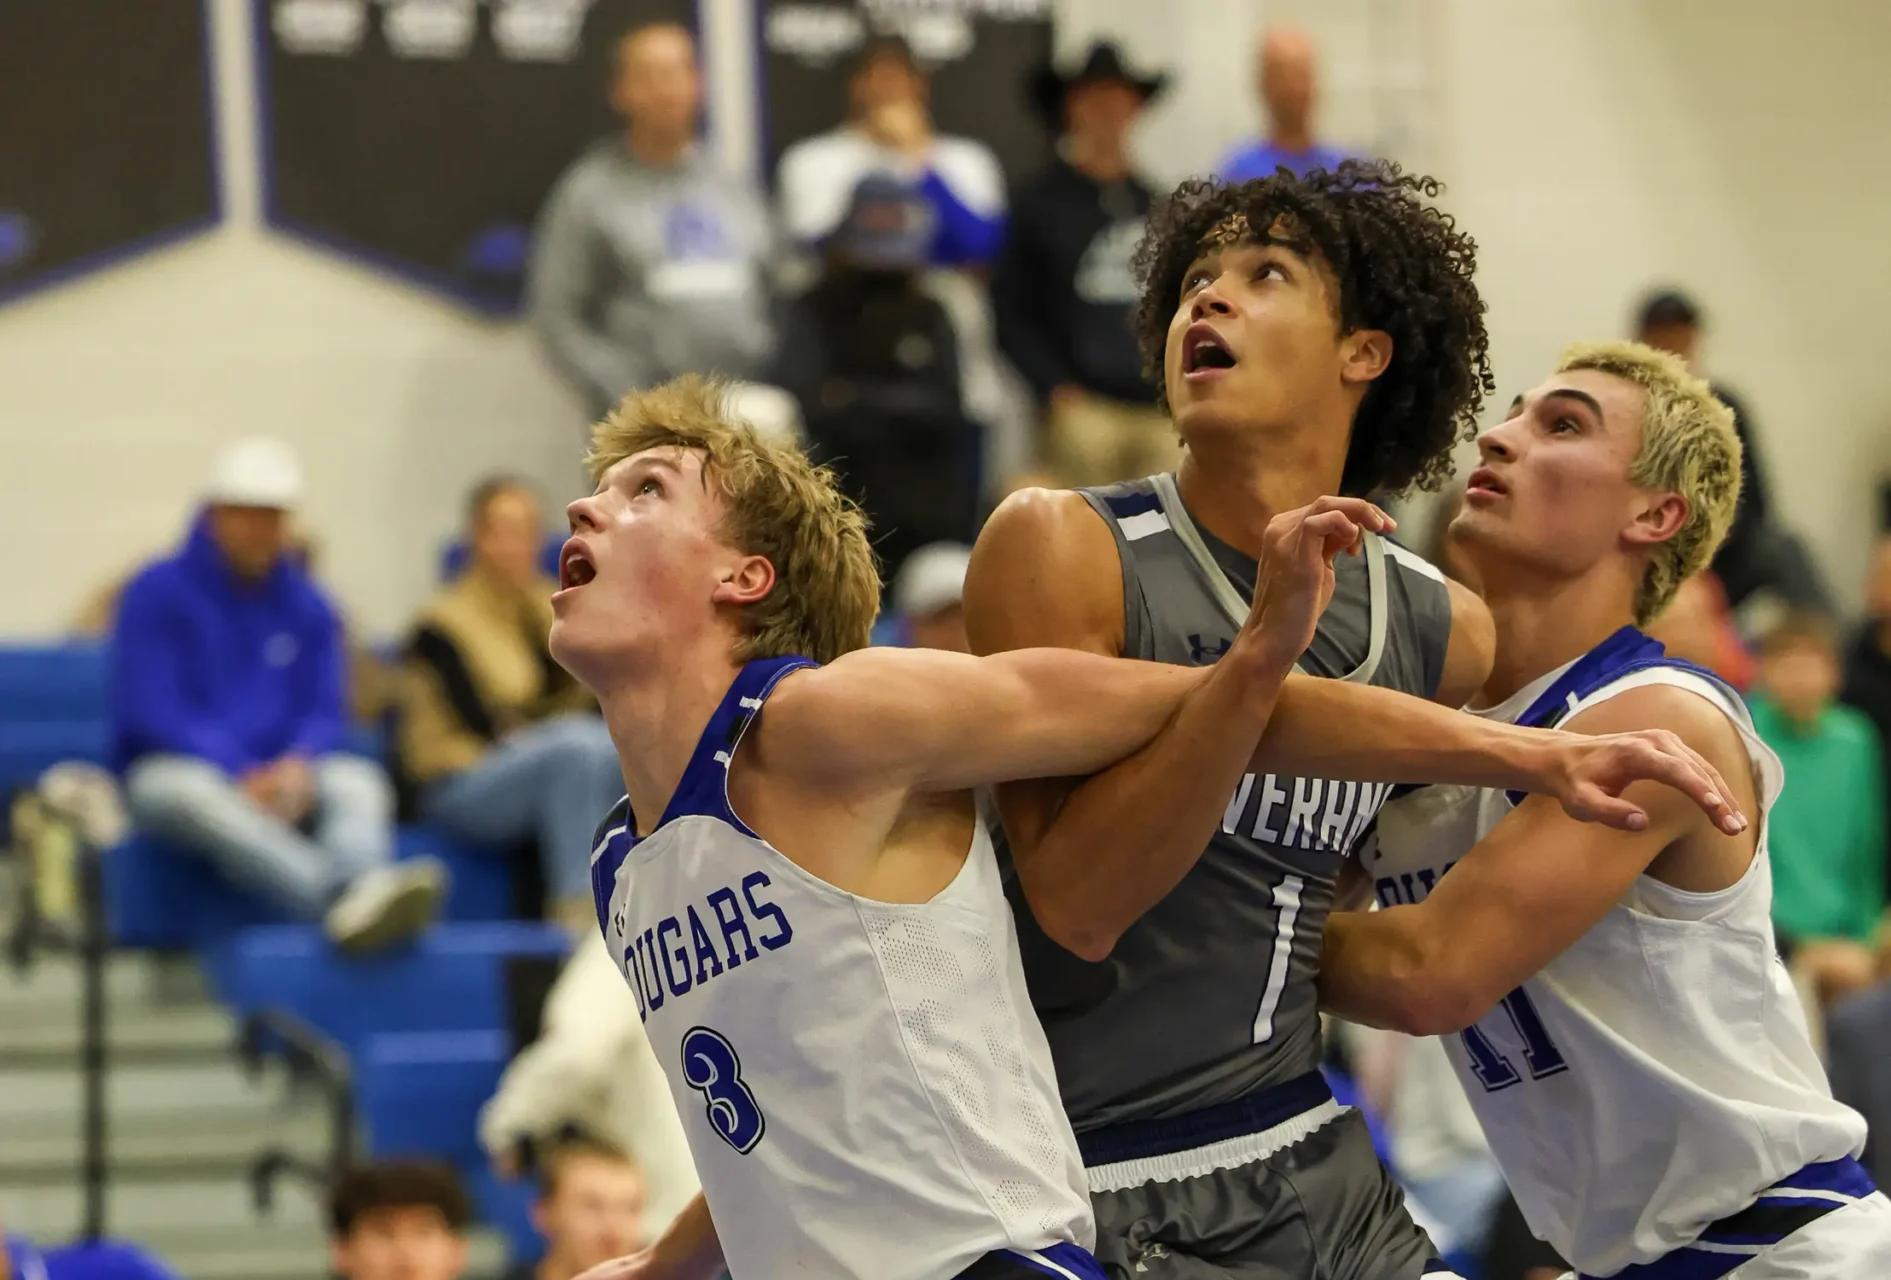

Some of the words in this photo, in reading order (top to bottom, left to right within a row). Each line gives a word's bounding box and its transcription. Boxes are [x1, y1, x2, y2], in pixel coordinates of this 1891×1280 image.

[1222, 772, 1394, 858] VERAN
[623, 870, 793, 1024] OUGARS
[1252, 873, 1304, 1044] 1
[680, 1025, 766, 1155] 3
